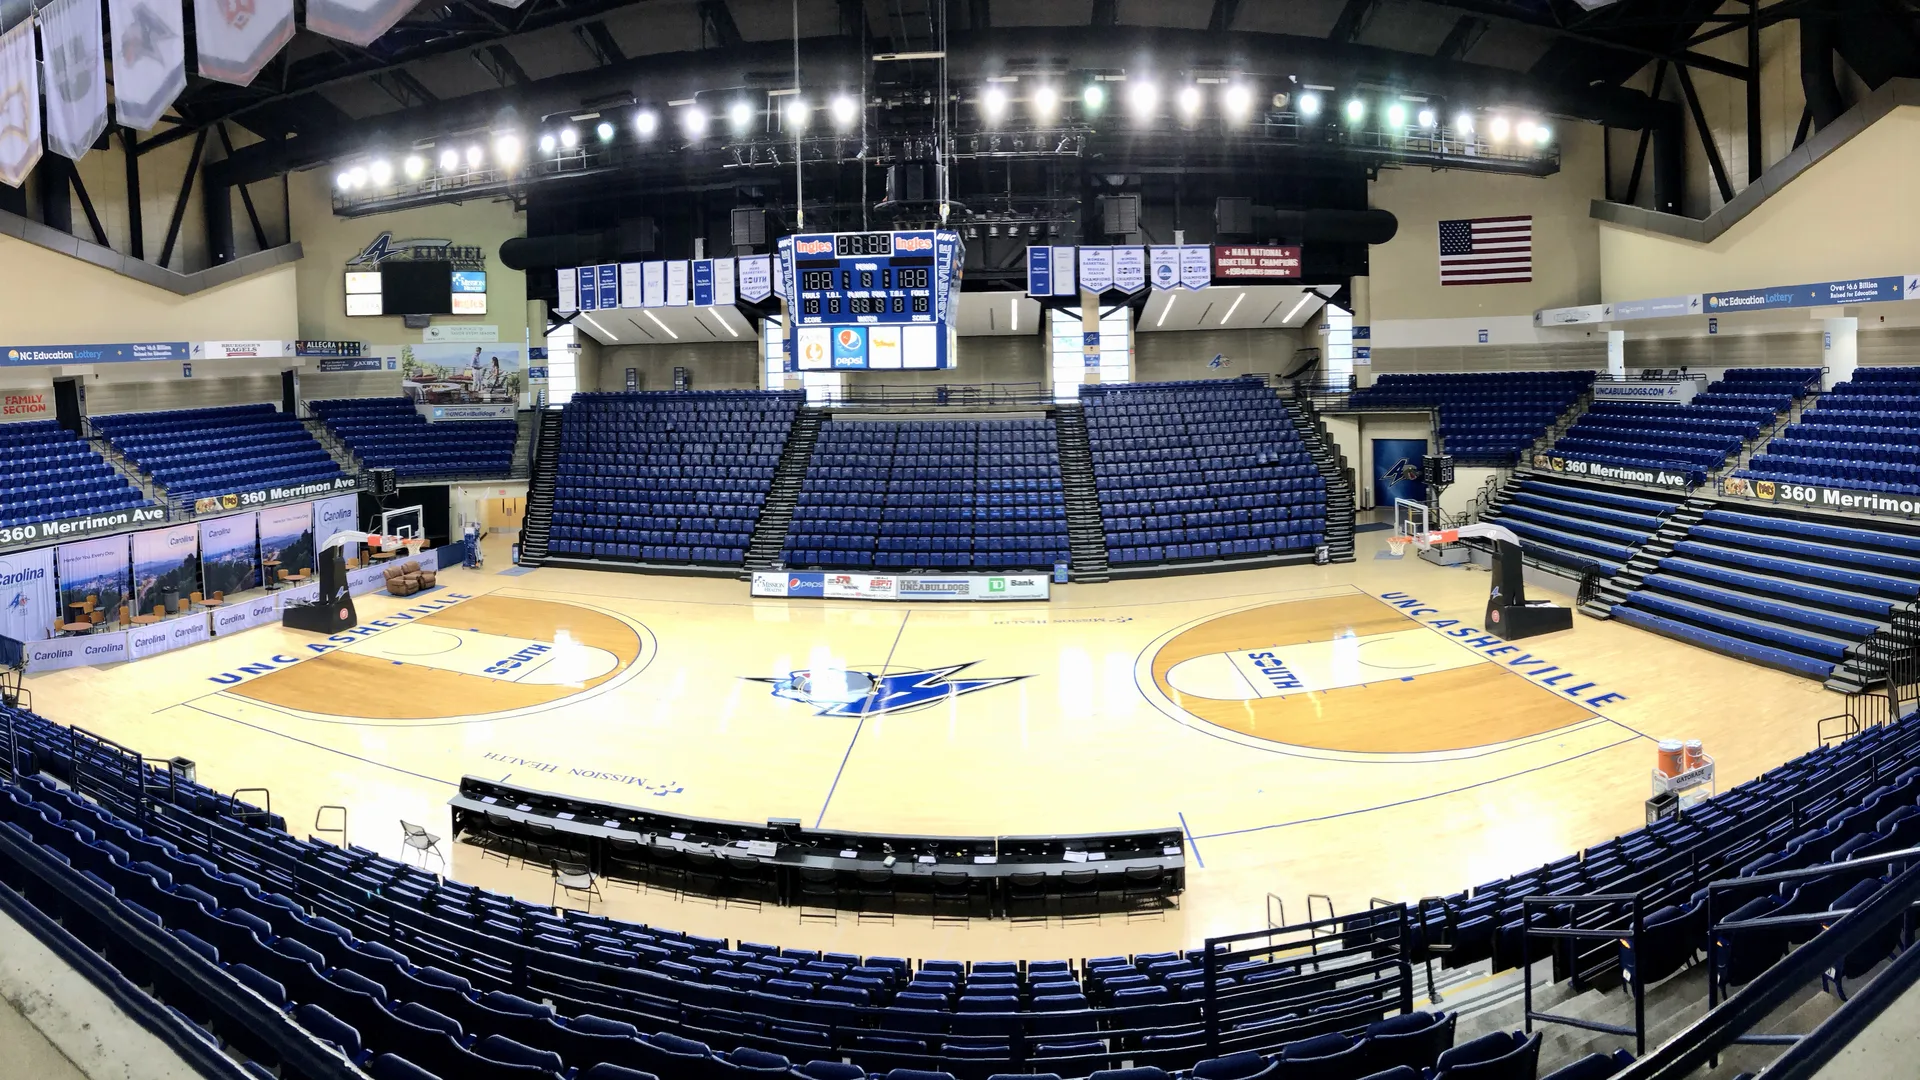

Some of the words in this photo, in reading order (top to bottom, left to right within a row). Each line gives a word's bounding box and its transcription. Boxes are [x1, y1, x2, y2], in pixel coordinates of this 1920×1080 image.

[796, 240, 832, 254] Ingles
[896, 236, 932, 251] Ingles
[414, 246, 486, 260] KIMMEL
[1218, 258, 1258, 266] BASKETBALL
[1260, 258, 1298, 266] CHAMPIONS
[938, 244, 952, 320] ASHEVILLE
[1858, 282, 1878, 290] Billion
[1718, 298, 1729, 307] NC
[1730, 295, 1765, 306] Education
[1765, 294, 1794, 304] Lottery
[20, 352, 32, 360] NC
[33, 350, 74, 360] Education
[74, 350, 102, 360] Lottery
[836, 356, 864, 366] pepsi
[1596, 388, 1664, 396] UNCABULLDOGS.COM
[5, 394, 43, 405] FAMILY
[3, 404, 46, 414] SECTION
[1565, 460, 1588, 474] 360
[1590, 463, 1654, 483] Merrimon
[1657, 471, 1684, 486] Ave
[241, 490, 266, 504] 360
[270, 482, 331, 500] Merrimon
[334, 478, 356, 488] Ave
[1780, 484, 1816, 502] 360
[1823, 489, 1920, 514] Merrimo
[324, 506, 352, 522] Carolina
[0, 526, 36, 543] 360
[42, 512, 128, 536] Merrimon
[132, 508, 164, 522] Ave
[208, 527, 231, 538] Carolina
[170, 534, 195, 546] Carolina
[836, 576, 851, 584] 570
[990, 580, 1004, 590] TD
[220, 613, 246, 626] Carolina
[174, 624, 204, 638] Carolina
[135, 633, 166, 648] Carolina
[208, 654, 300, 685] UNC
[306, 592, 472, 653] ASHEVILLE
[34, 648, 73, 661] Carolina
[85, 642, 124, 655] Carolina
[1380, 590, 1440, 616] UNC
[1433, 618, 1628, 708] ASHEVILLE
[484, 644, 552, 674] SOUTH
[1248, 652, 1304, 689] SOUTH
[483, 752, 559, 773] HEALTH
[568, 768, 650, 787] MISSION
[1676, 768, 1705, 784] GATORADE
